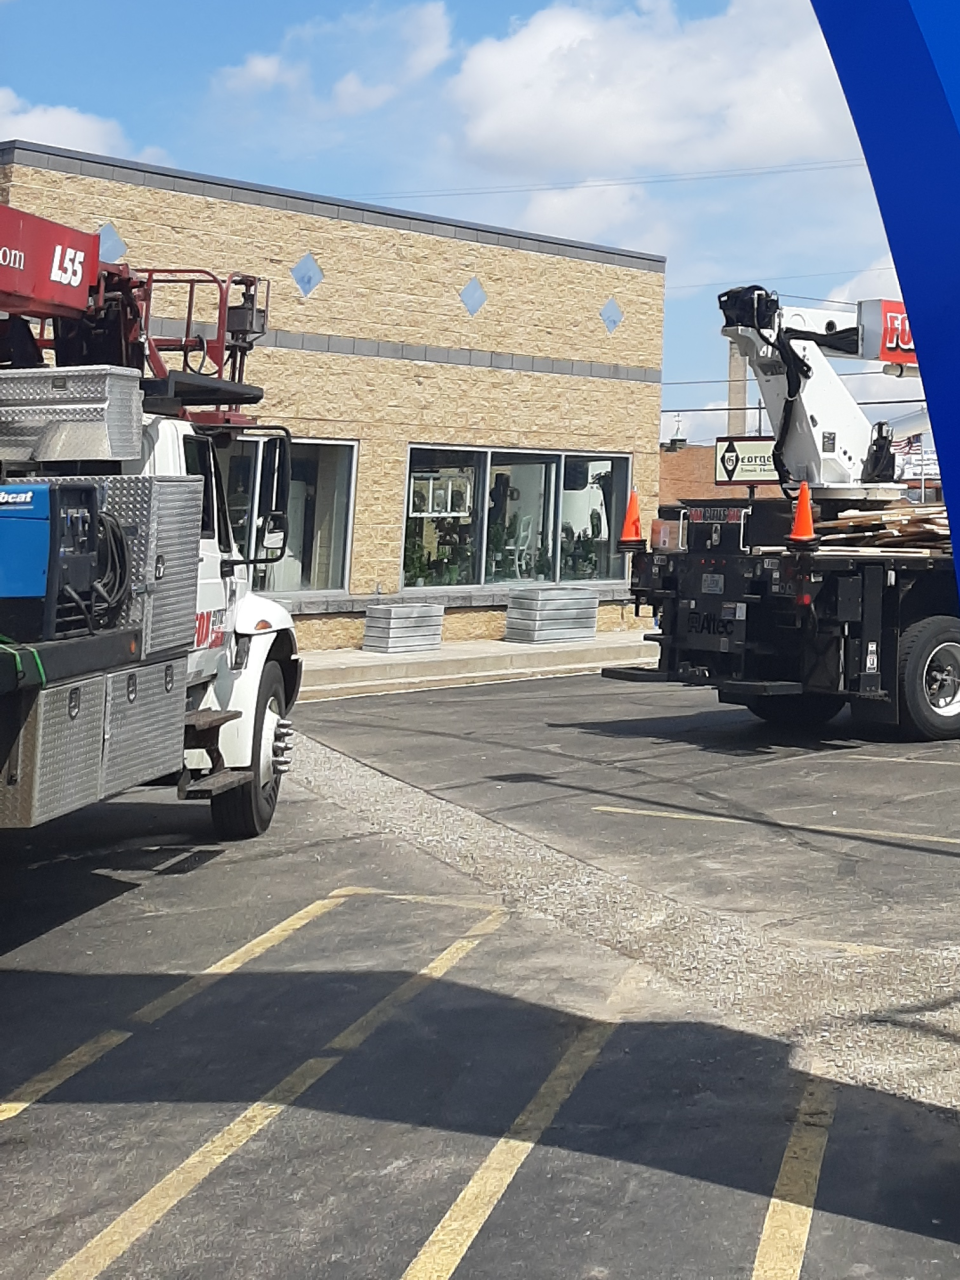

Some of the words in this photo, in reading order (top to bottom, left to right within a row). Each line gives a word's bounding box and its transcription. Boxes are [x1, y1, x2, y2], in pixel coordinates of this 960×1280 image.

[0, 246, 24, 270] om
[50, 244, 85, 287] L55
[886, 312, 915, 349] FO
[0, 491, 33, 503] bcat
